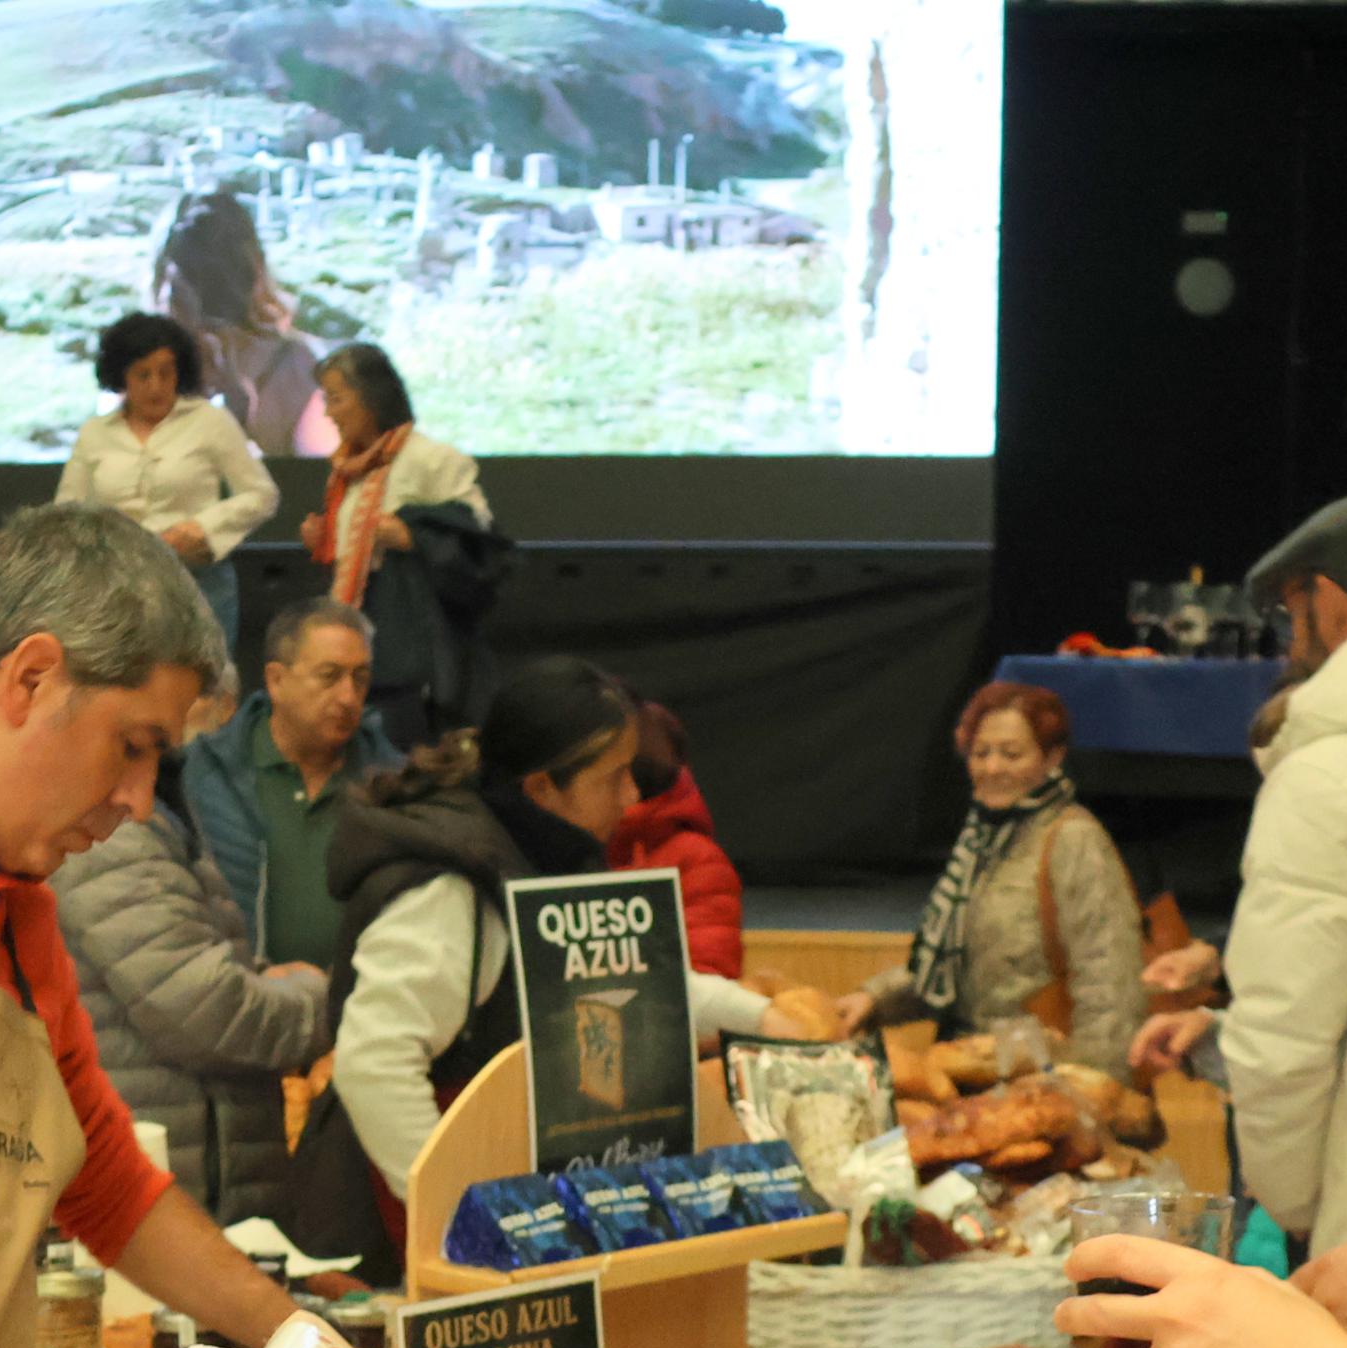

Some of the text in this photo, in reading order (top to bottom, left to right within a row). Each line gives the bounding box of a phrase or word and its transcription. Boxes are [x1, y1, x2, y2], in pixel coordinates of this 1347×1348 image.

[538, 896, 652, 947] QUESO
[564, 935, 648, 982] AZUL
[516, 1295, 578, 1343] AZUL
